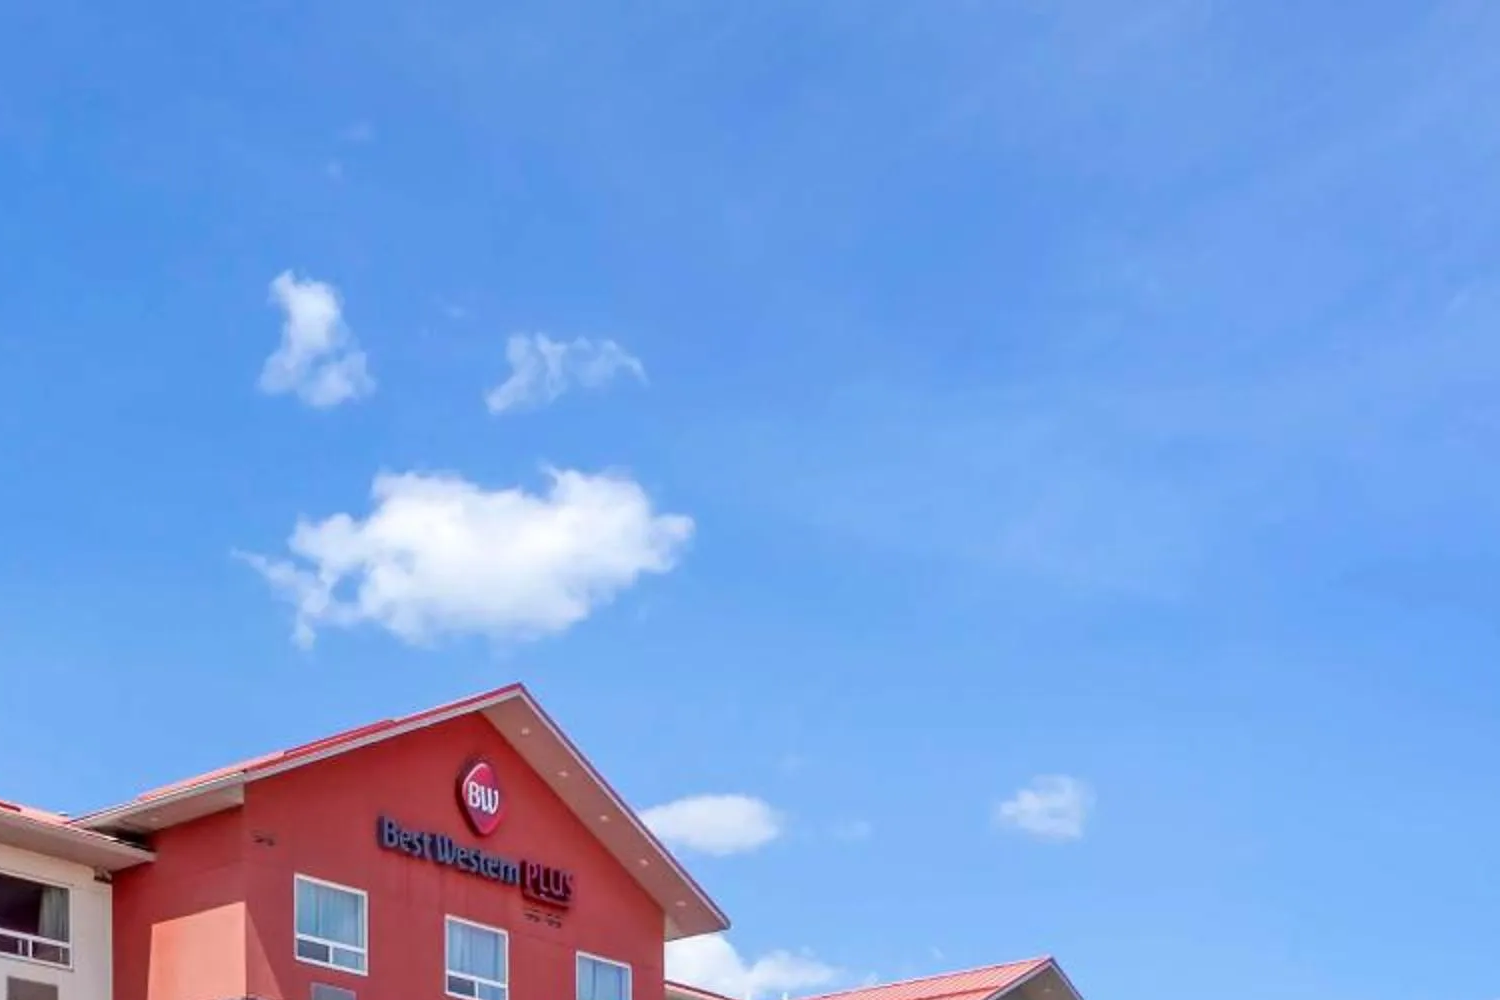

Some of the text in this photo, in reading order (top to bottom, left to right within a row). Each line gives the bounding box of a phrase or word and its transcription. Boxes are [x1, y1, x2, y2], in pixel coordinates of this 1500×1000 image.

[467, 781, 499, 815] BW
[381, 816, 573, 898] Best Western PLUS
